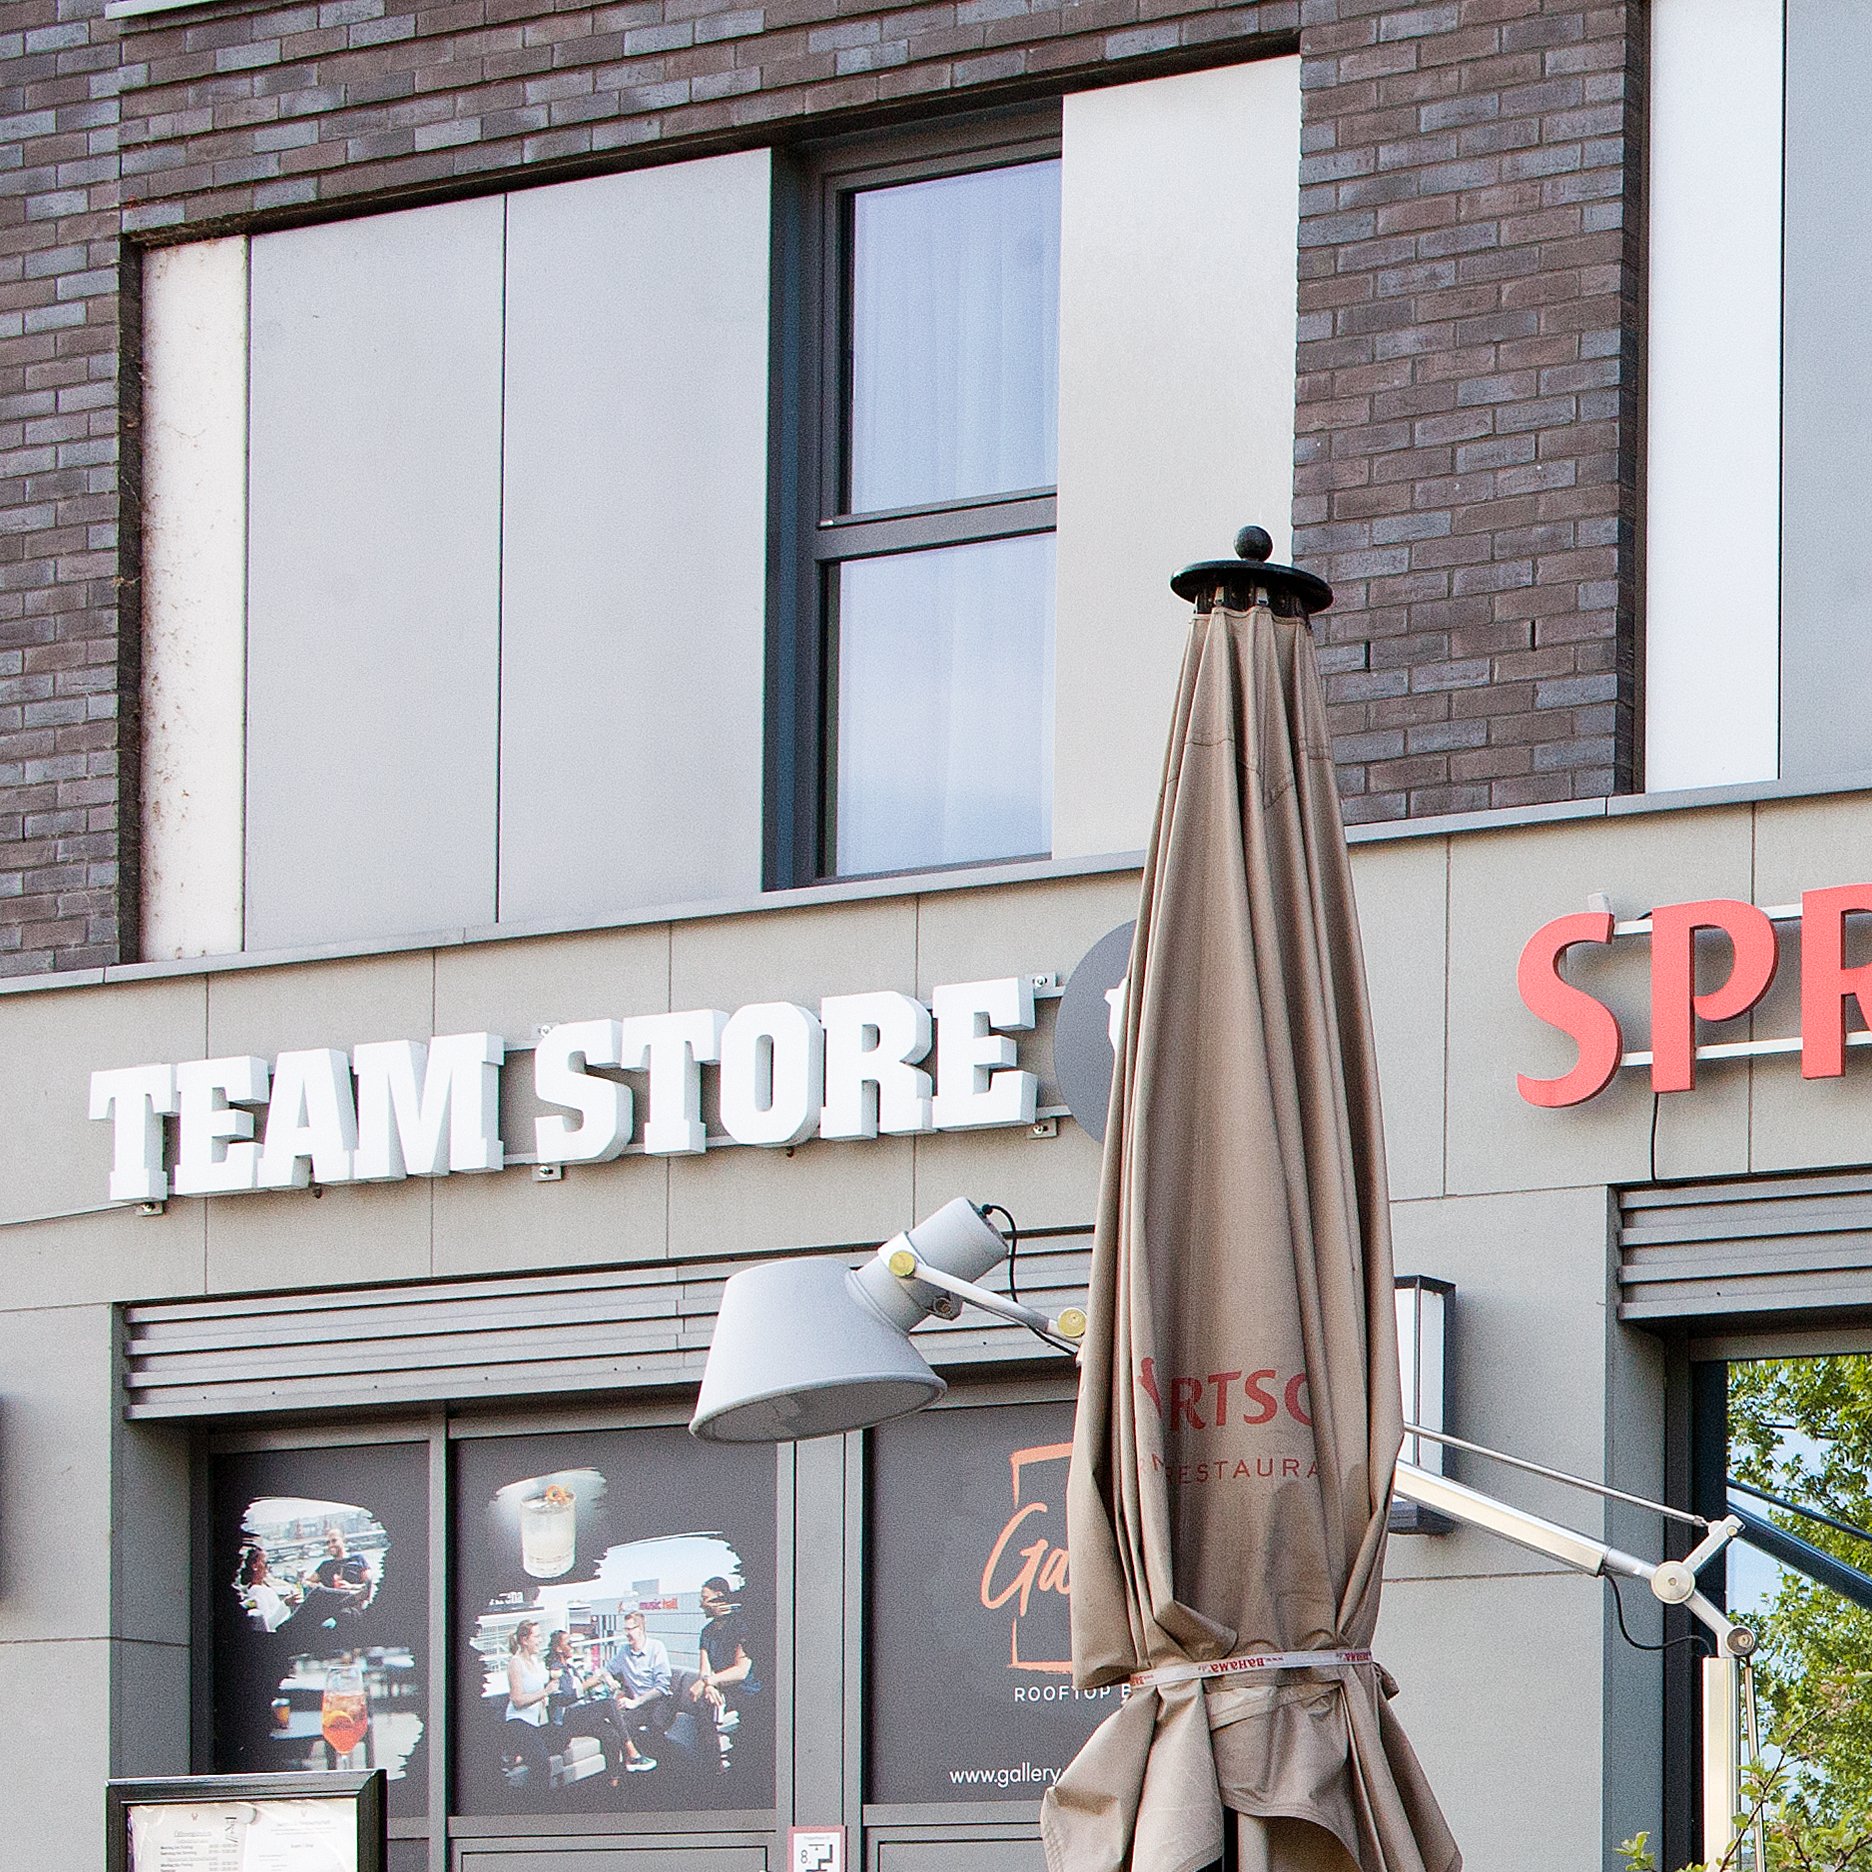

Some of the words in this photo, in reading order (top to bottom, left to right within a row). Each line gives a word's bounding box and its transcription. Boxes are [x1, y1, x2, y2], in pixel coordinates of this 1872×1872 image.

[89, 1031, 505, 1202] TEAM
[535, 977, 1038, 1165] STORE
[949, 1762, 1063, 1788] www.gallery
